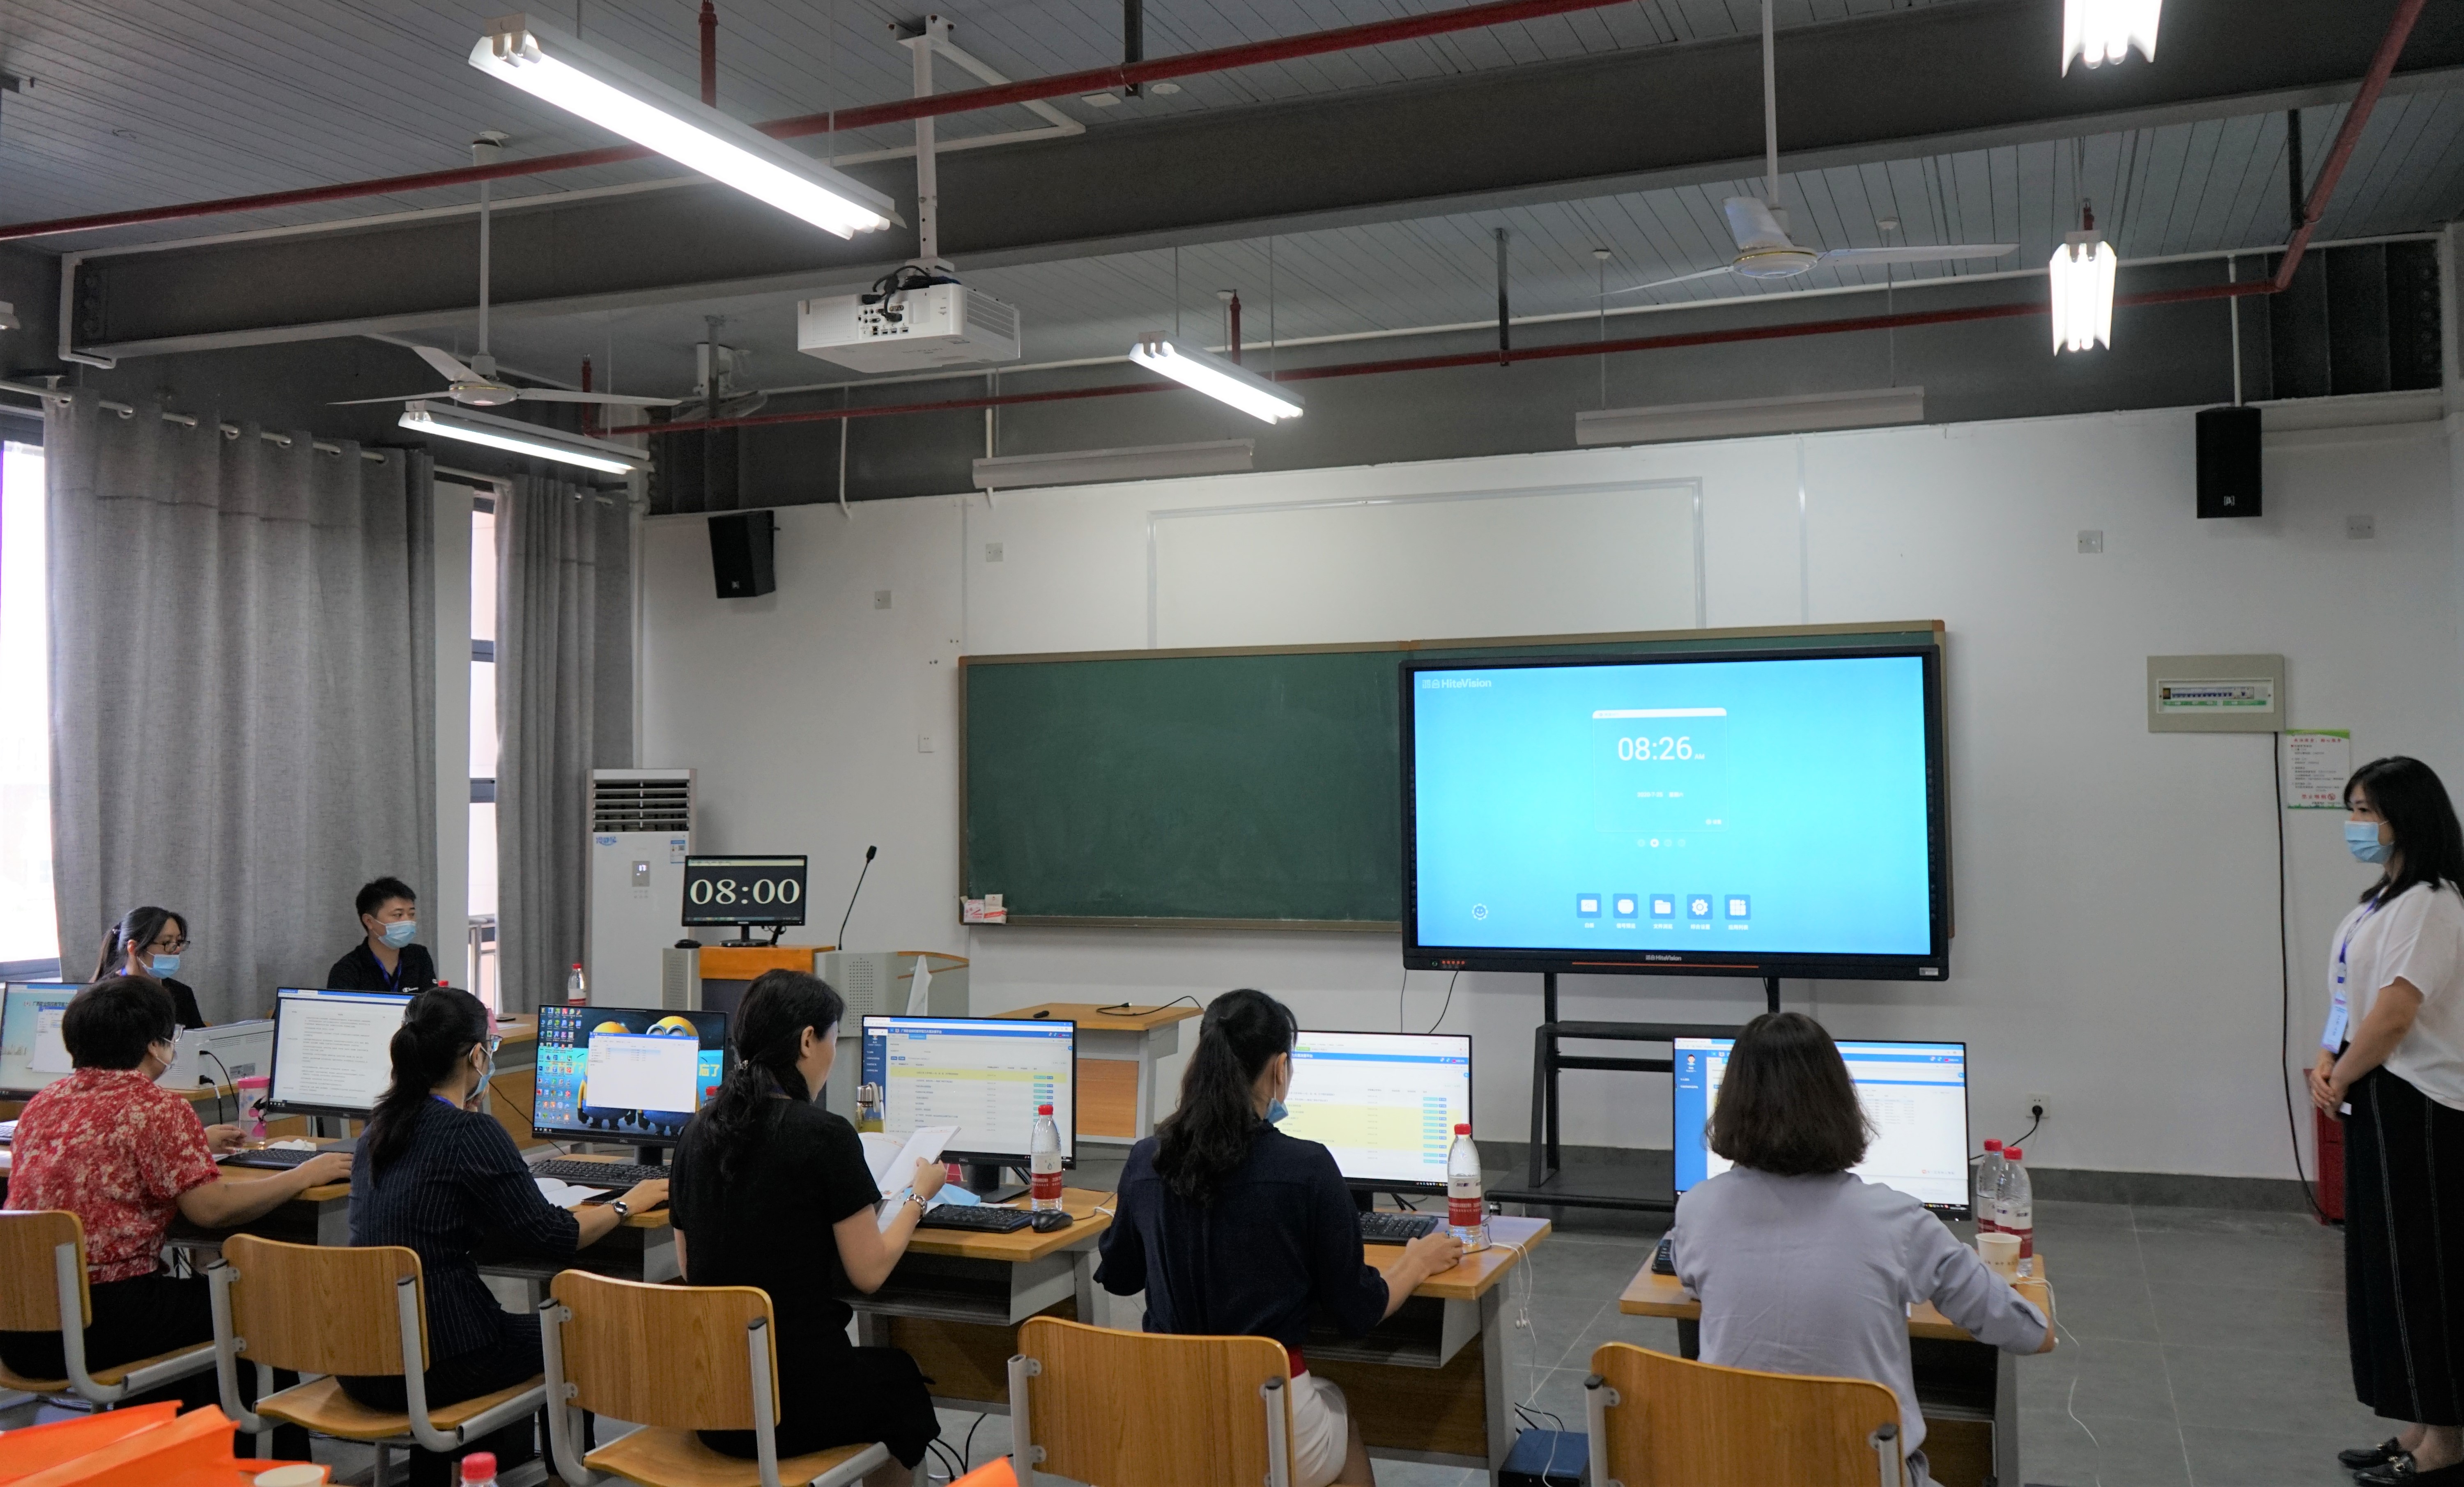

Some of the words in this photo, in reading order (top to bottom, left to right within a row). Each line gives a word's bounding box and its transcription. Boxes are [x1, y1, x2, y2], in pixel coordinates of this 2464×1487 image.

[1441, 678, 1492, 688] HiteVision
[1618, 736, 1692, 761] 08:26
[690, 879, 800, 904] 08:00
